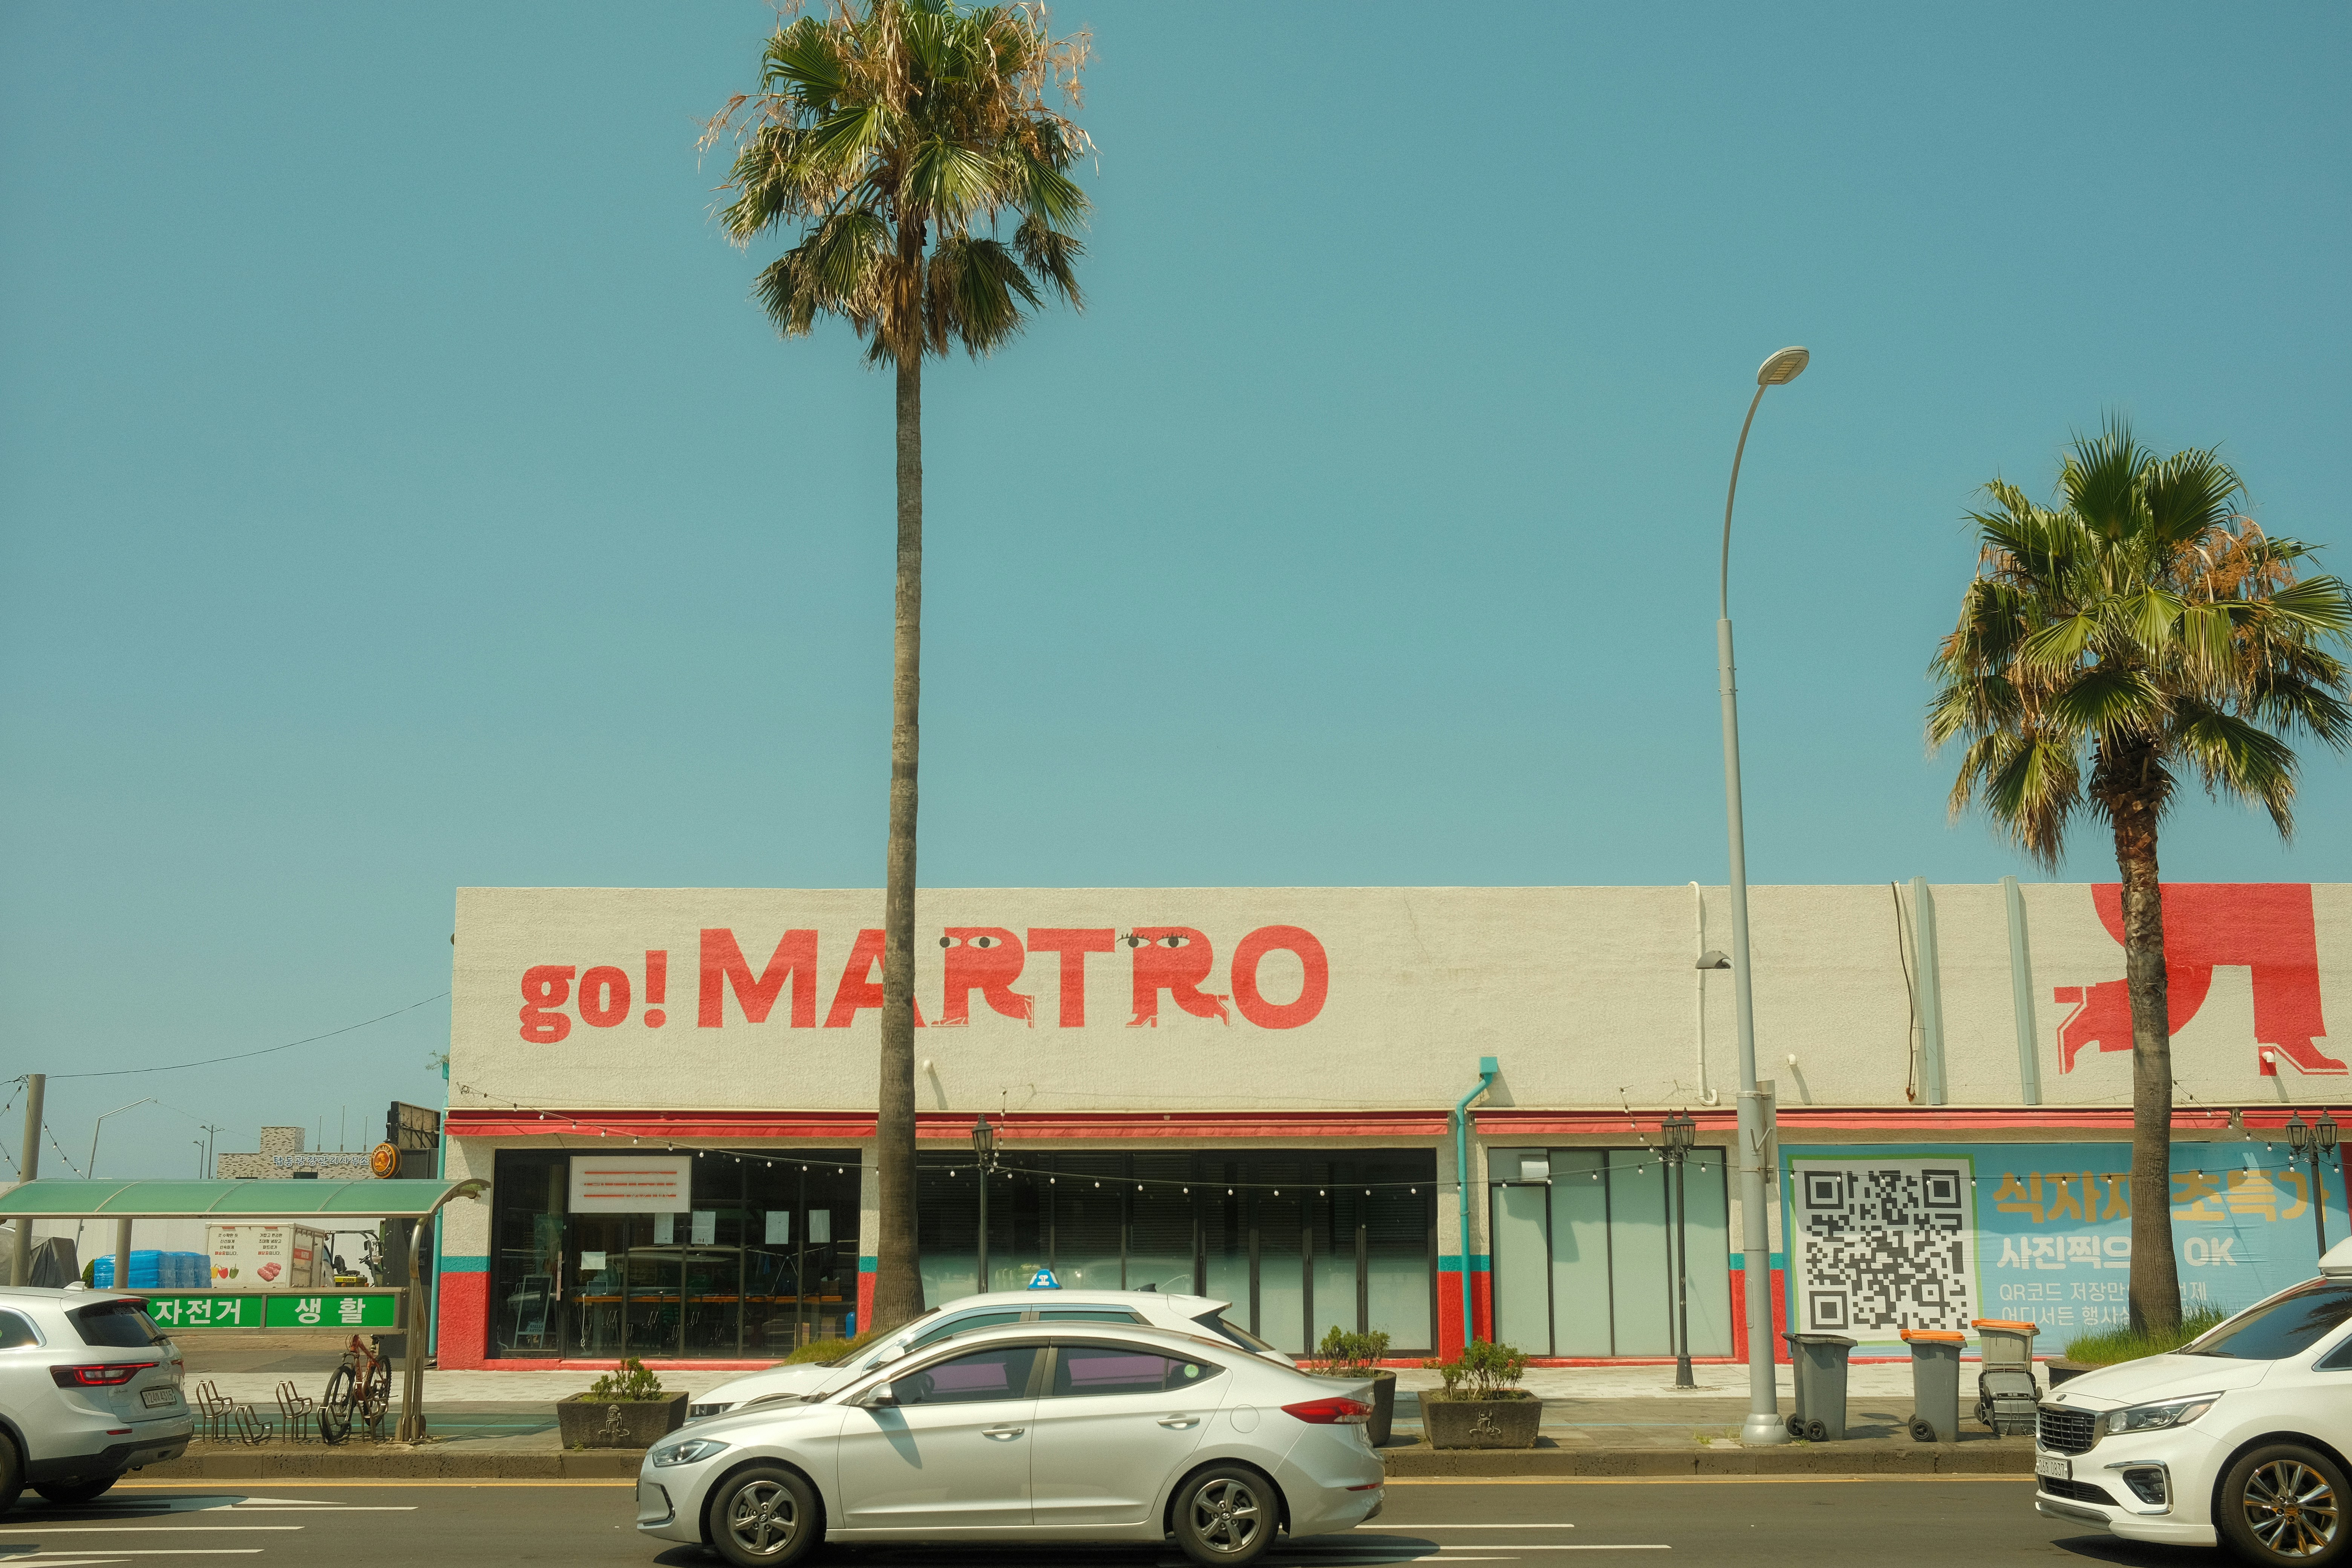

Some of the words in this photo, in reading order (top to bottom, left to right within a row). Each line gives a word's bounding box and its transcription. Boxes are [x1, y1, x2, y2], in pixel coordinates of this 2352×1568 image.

[520, 951, 667, 1043] go!
[273, 1155, 370, 1167] 탑동광장관리사무소
[2171, 1169, 2330, 1222] 초특가
[1997, 1235, 2132, 1270] 사진찍으
[2184, 1237, 2237, 1267] OK
[2000, 1283, 2063, 1301] QR코드
[2070, 1282, 2130, 1302] 저장만
[154, 1298, 241, 1325] 자전거
[2002, 1306, 2074, 1326] 어디서든
[2051, 1461, 2064, 1476] 0837
